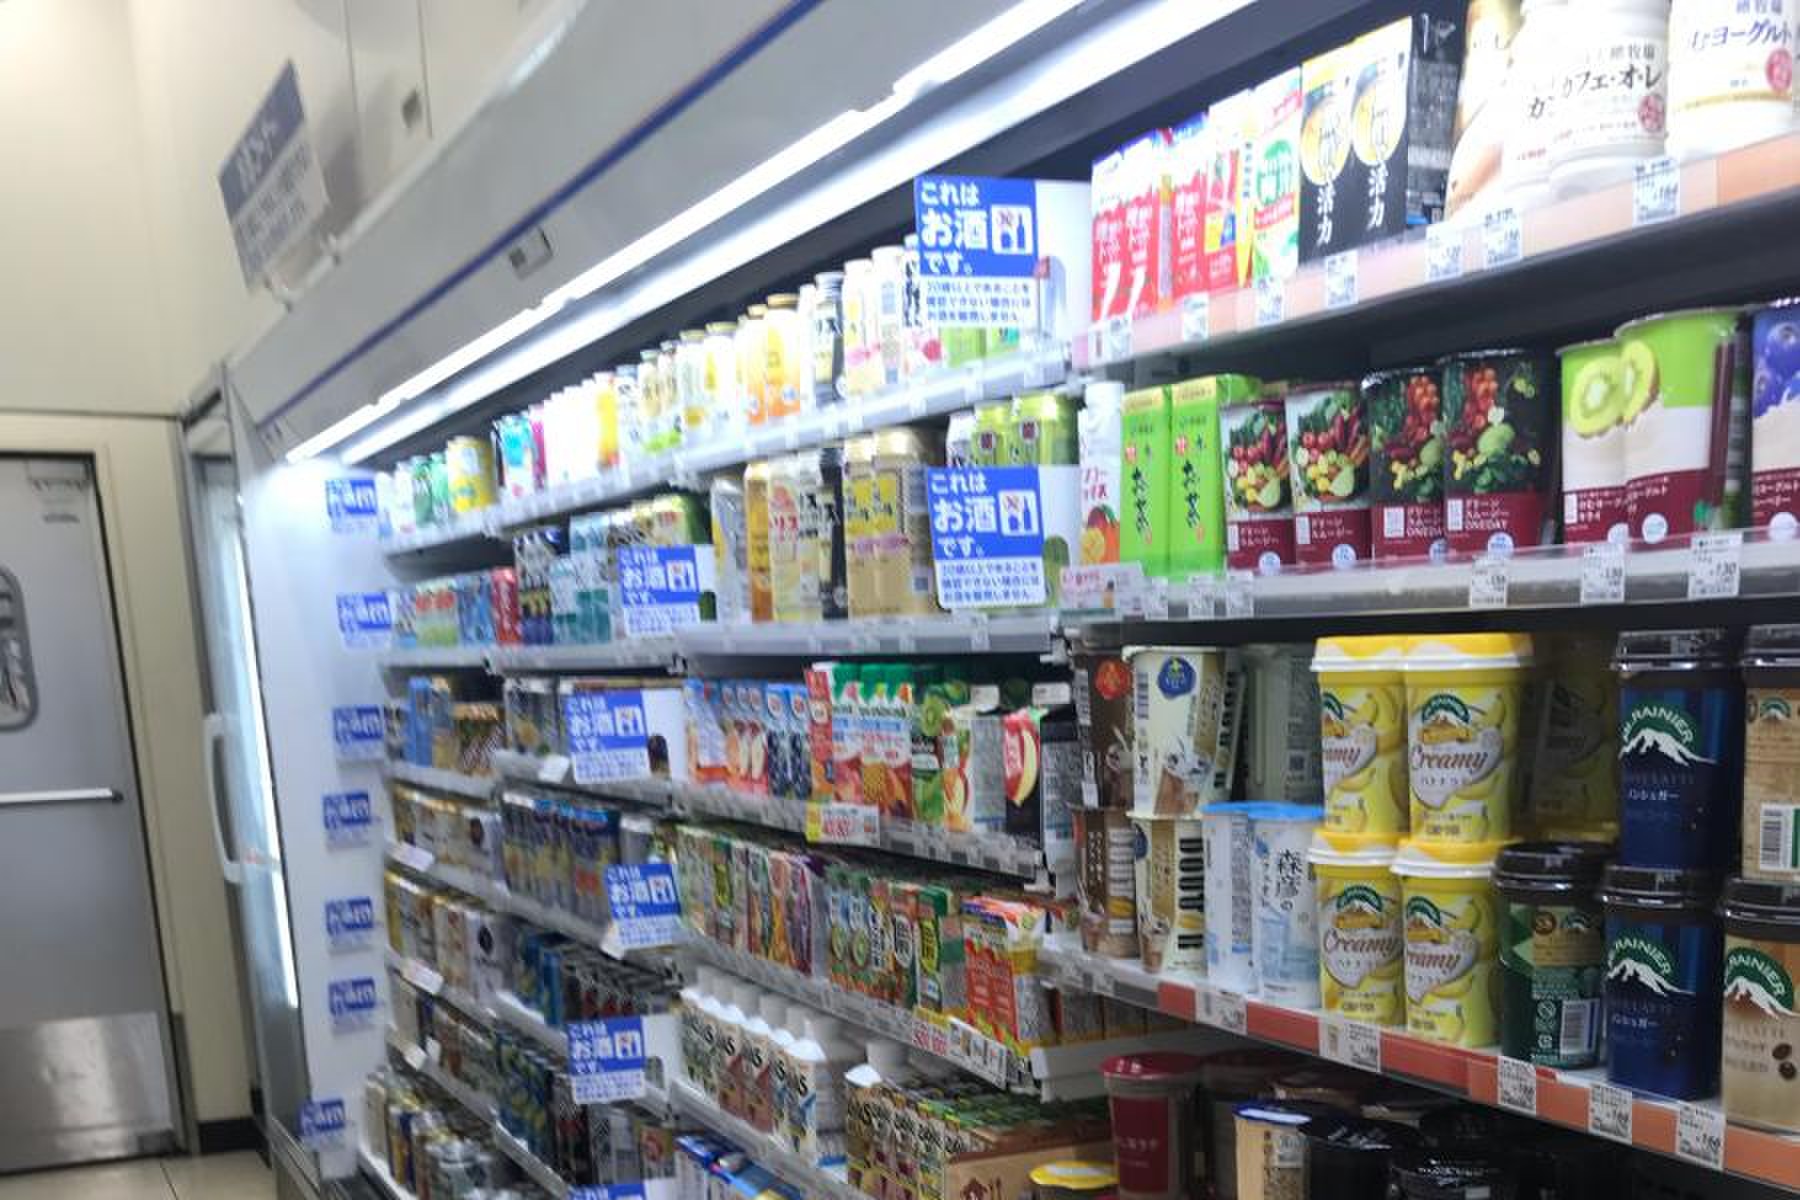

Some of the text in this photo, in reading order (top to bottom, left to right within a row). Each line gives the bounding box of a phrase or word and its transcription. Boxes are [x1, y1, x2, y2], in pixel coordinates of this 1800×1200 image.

[921, 181, 980, 206] これは
[921, 207, 988, 250] お酒
[931, 473, 988, 494] これは
[933, 497, 997, 533] お酒
[1411, 744, 1489, 776] Creamy
